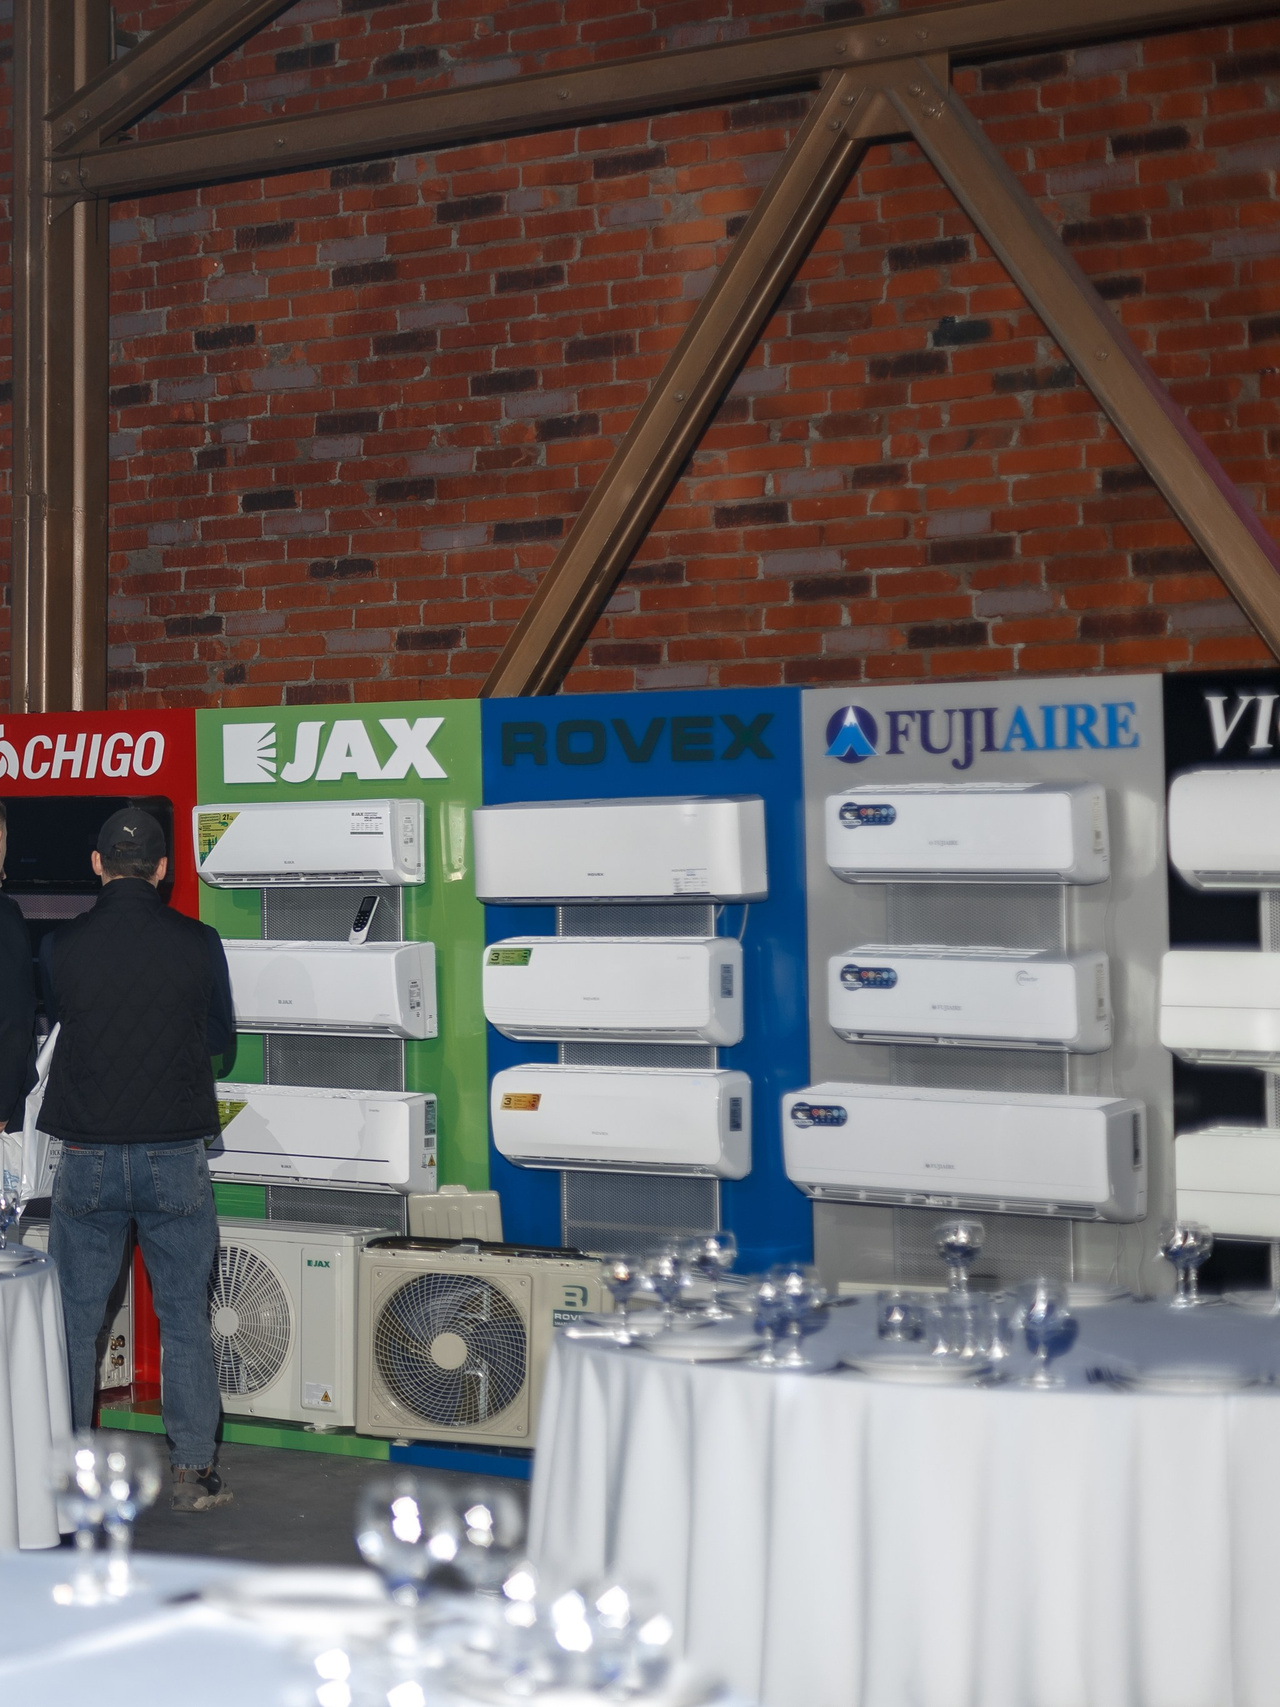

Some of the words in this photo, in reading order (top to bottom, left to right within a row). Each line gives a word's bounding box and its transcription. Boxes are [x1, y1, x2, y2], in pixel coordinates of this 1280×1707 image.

[501, 712, 775, 767] ROVEX
[885, 701, 1141, 770] FUJIAIRE
[1204, 694, 1280, 749] VI
[22, 730, 166, 780] CHIGO
[279, 716, 448, 783] JAX
[490, 952, 500, 962] 3
[503, 1097, 512, 1106] 3
